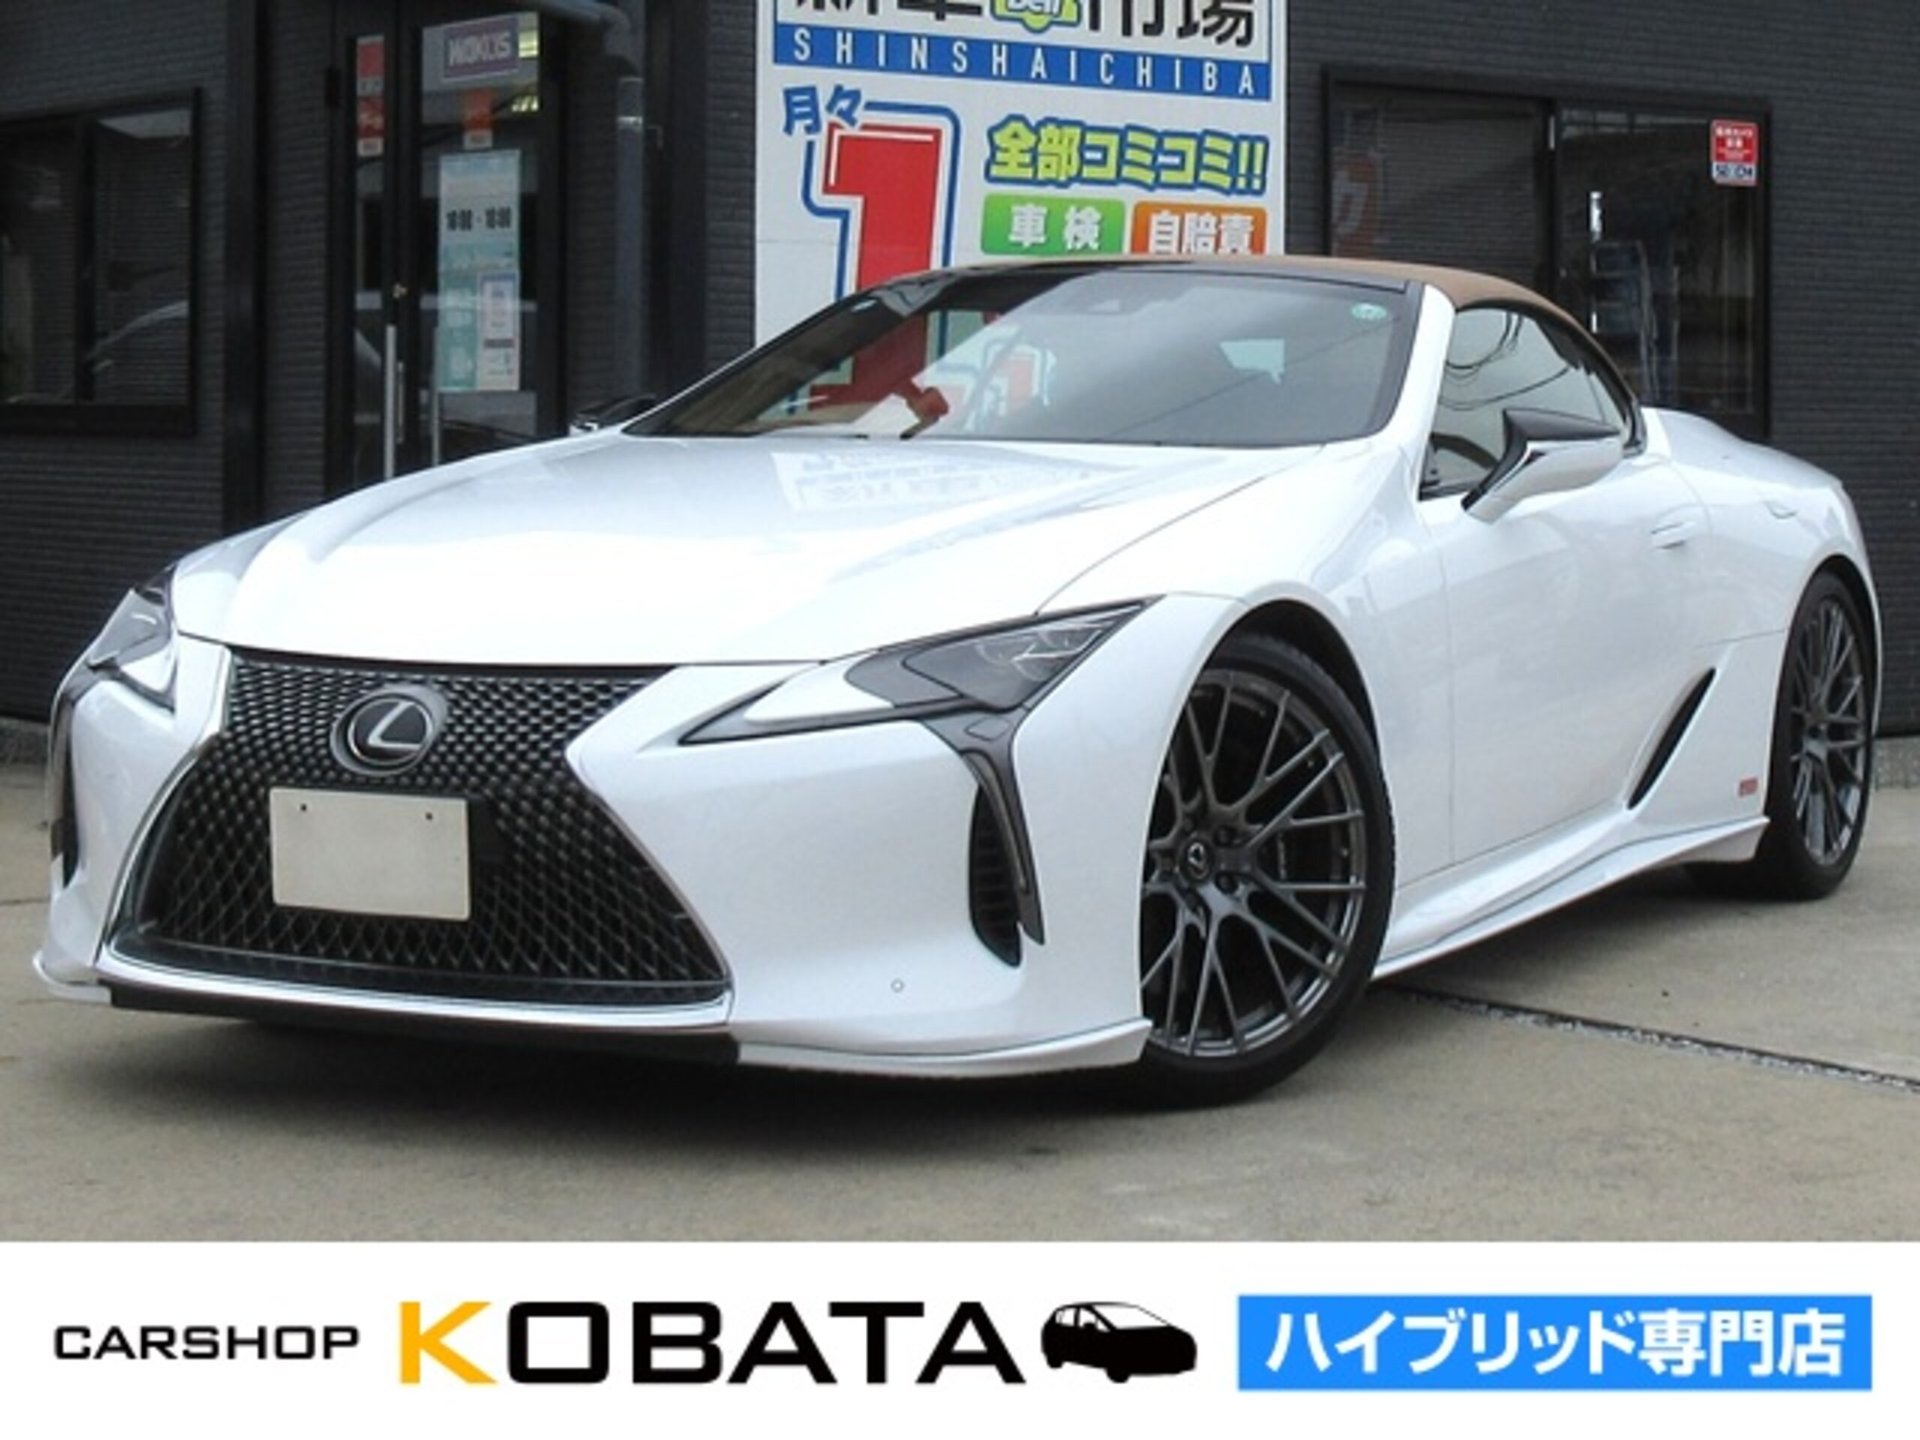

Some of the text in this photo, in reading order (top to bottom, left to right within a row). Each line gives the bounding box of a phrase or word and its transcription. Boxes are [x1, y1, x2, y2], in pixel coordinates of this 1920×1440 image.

[794, 26, 1254, 96] SHINSHAICHIBA
[783, 84, 862, 136] 月々
[1008, 203, 1102, 250] 車検
[1148, 210, 1254, 254] 自賠責
